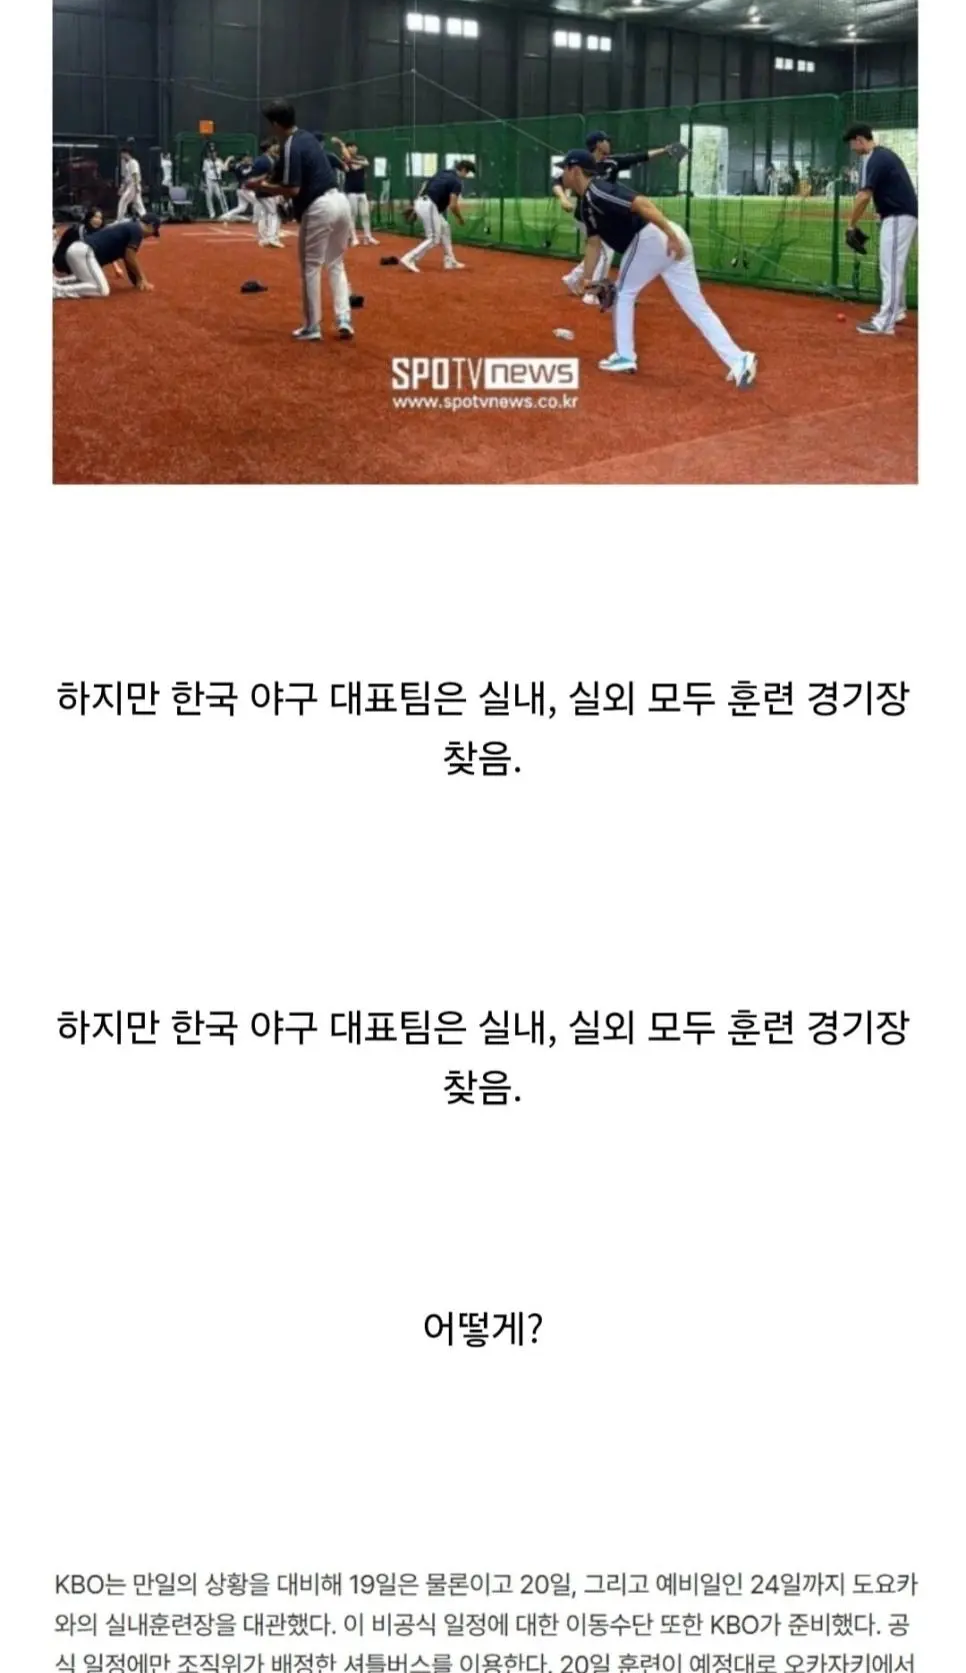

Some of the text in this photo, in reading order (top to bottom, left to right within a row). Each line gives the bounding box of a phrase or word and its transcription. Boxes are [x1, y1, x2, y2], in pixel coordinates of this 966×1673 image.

[57, 680, 910, 719] 하지만 한국 야구 대표팀은 실내, 실외 모두 훈련 경기장
[444, 740, 520, 776] 찾음.
[424, 1311, 542, 1348] 어떻게?
[56, 1572, 918, 1599] KBO는 만일의 상황을 대비해 19일은 물론이고 20일, 그리고 예비일인 24일까지 도요카
